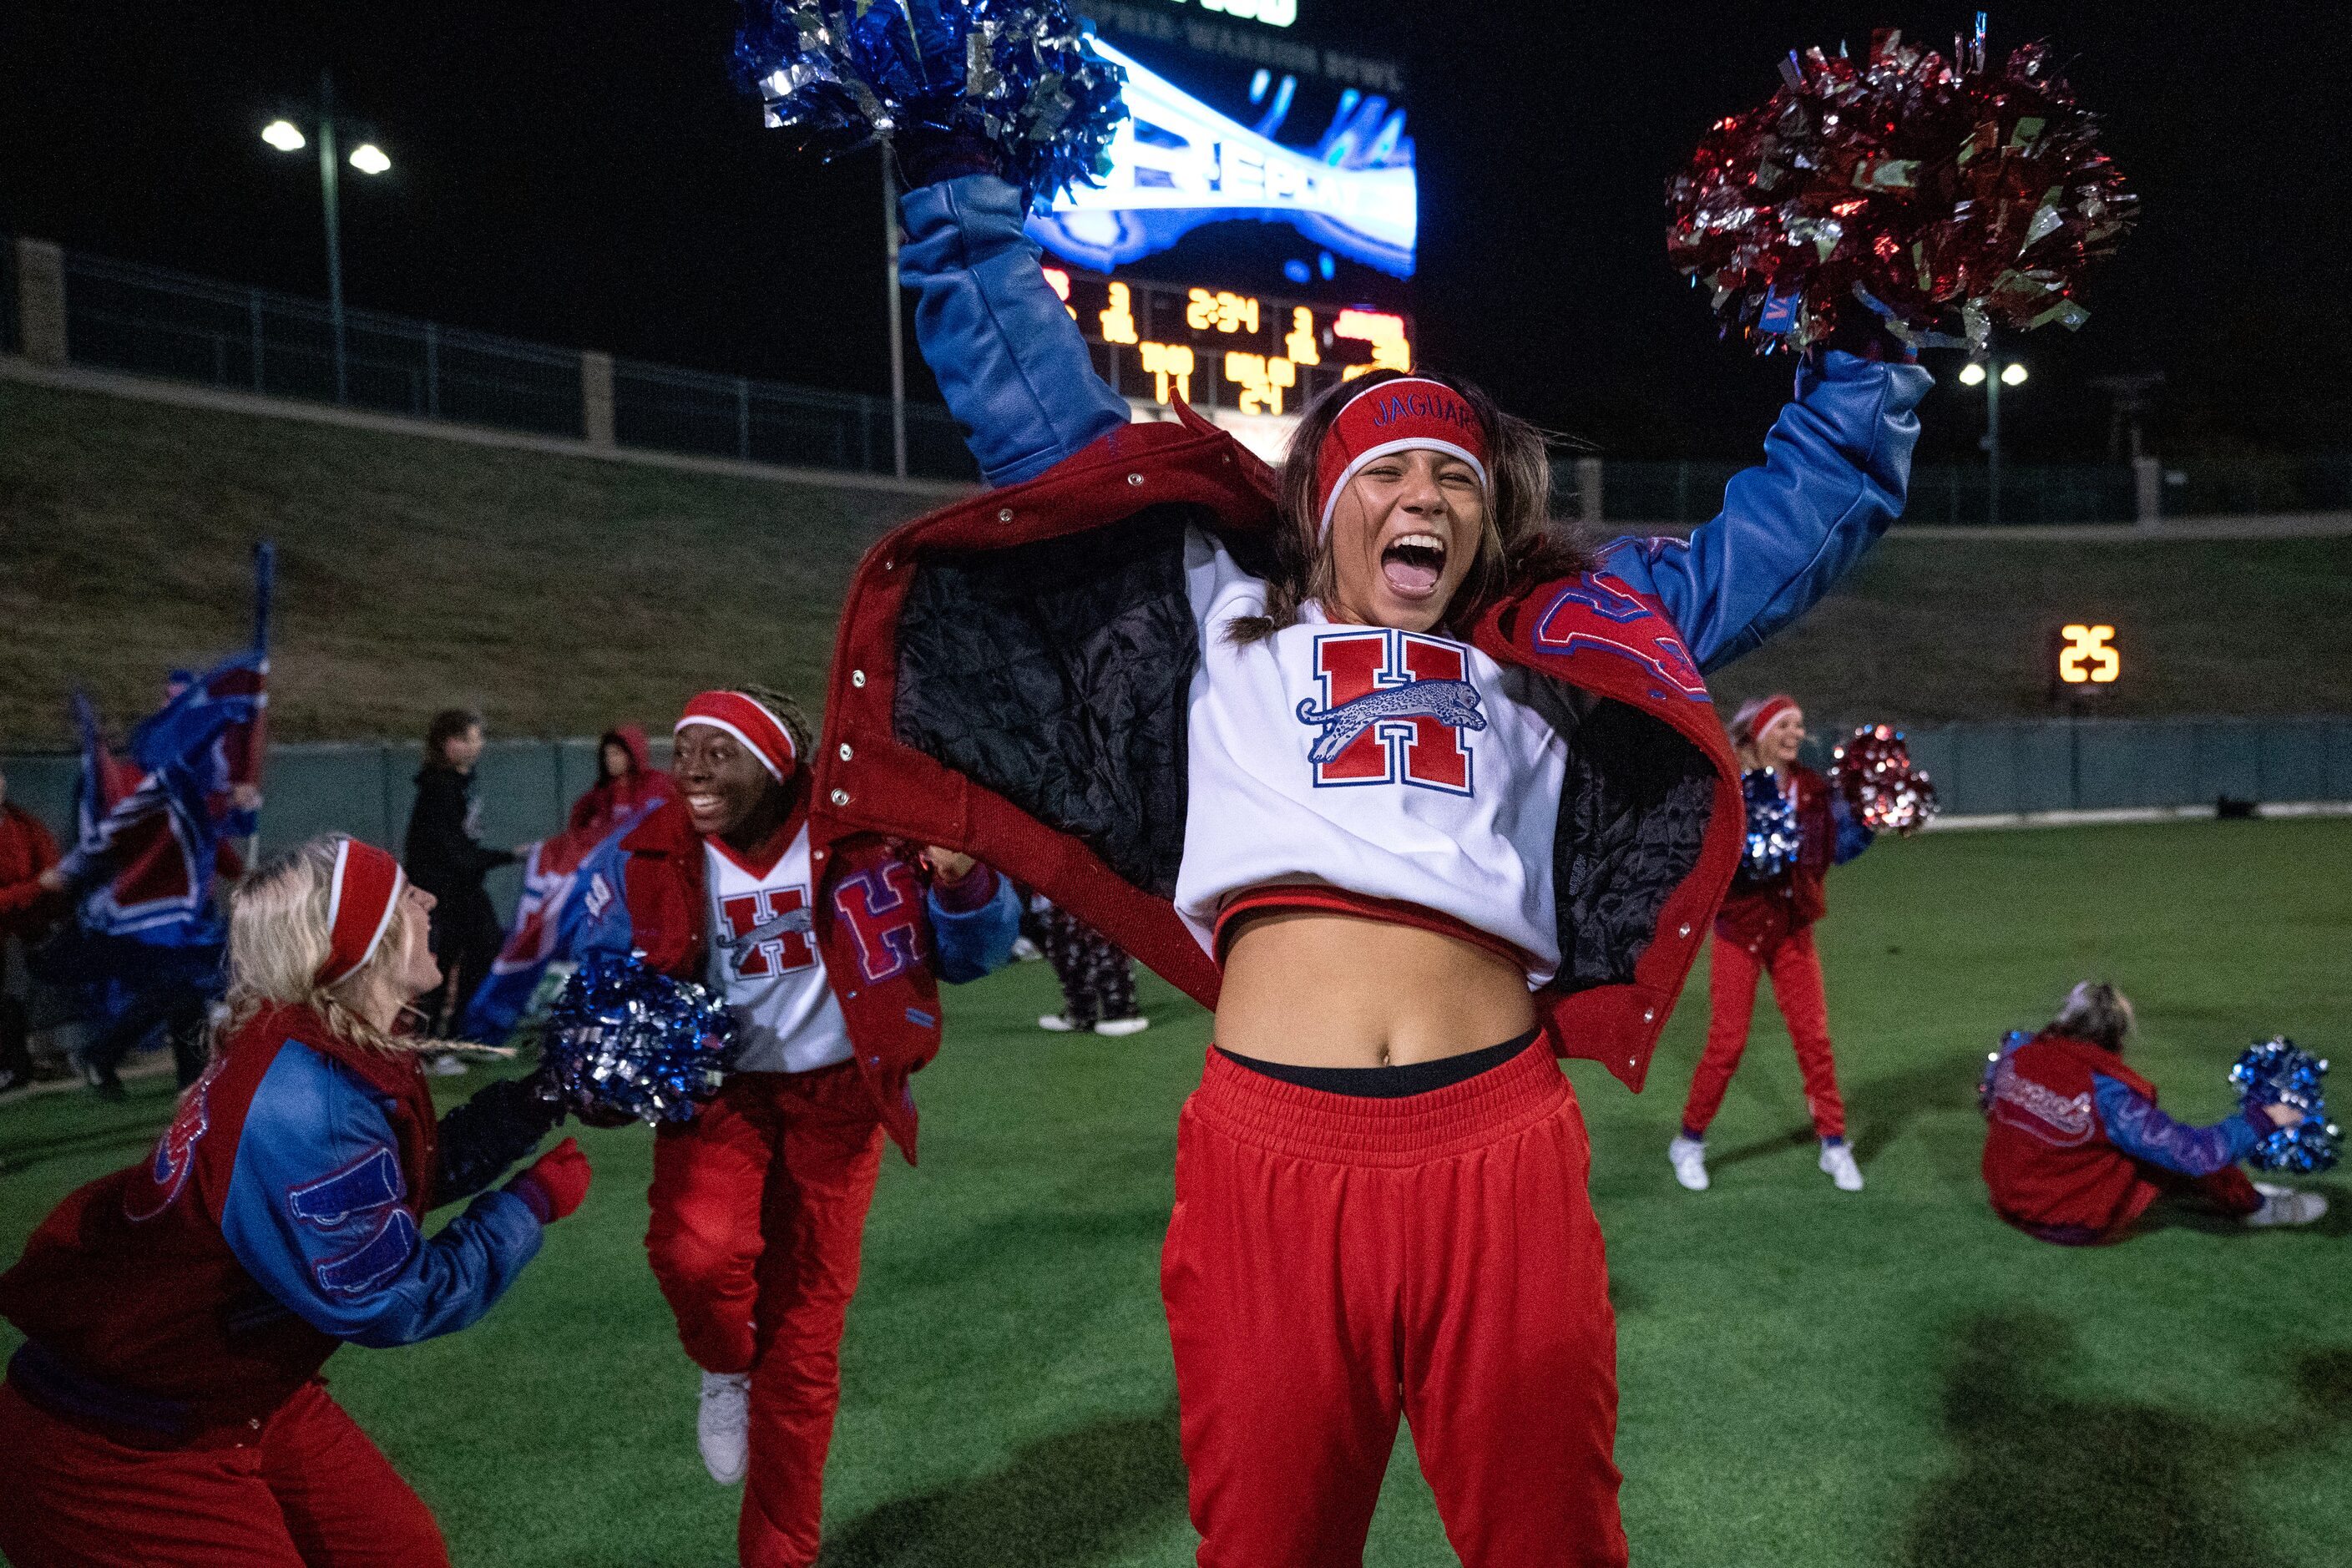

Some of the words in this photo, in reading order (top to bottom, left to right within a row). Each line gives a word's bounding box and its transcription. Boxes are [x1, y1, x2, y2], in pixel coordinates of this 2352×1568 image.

[1186, 287, 1259, 333] 2:34
[2060, 625, 2120, 683] 25
[1313, 629, 1474, 798] H
[718, 883, 820, 981] H
